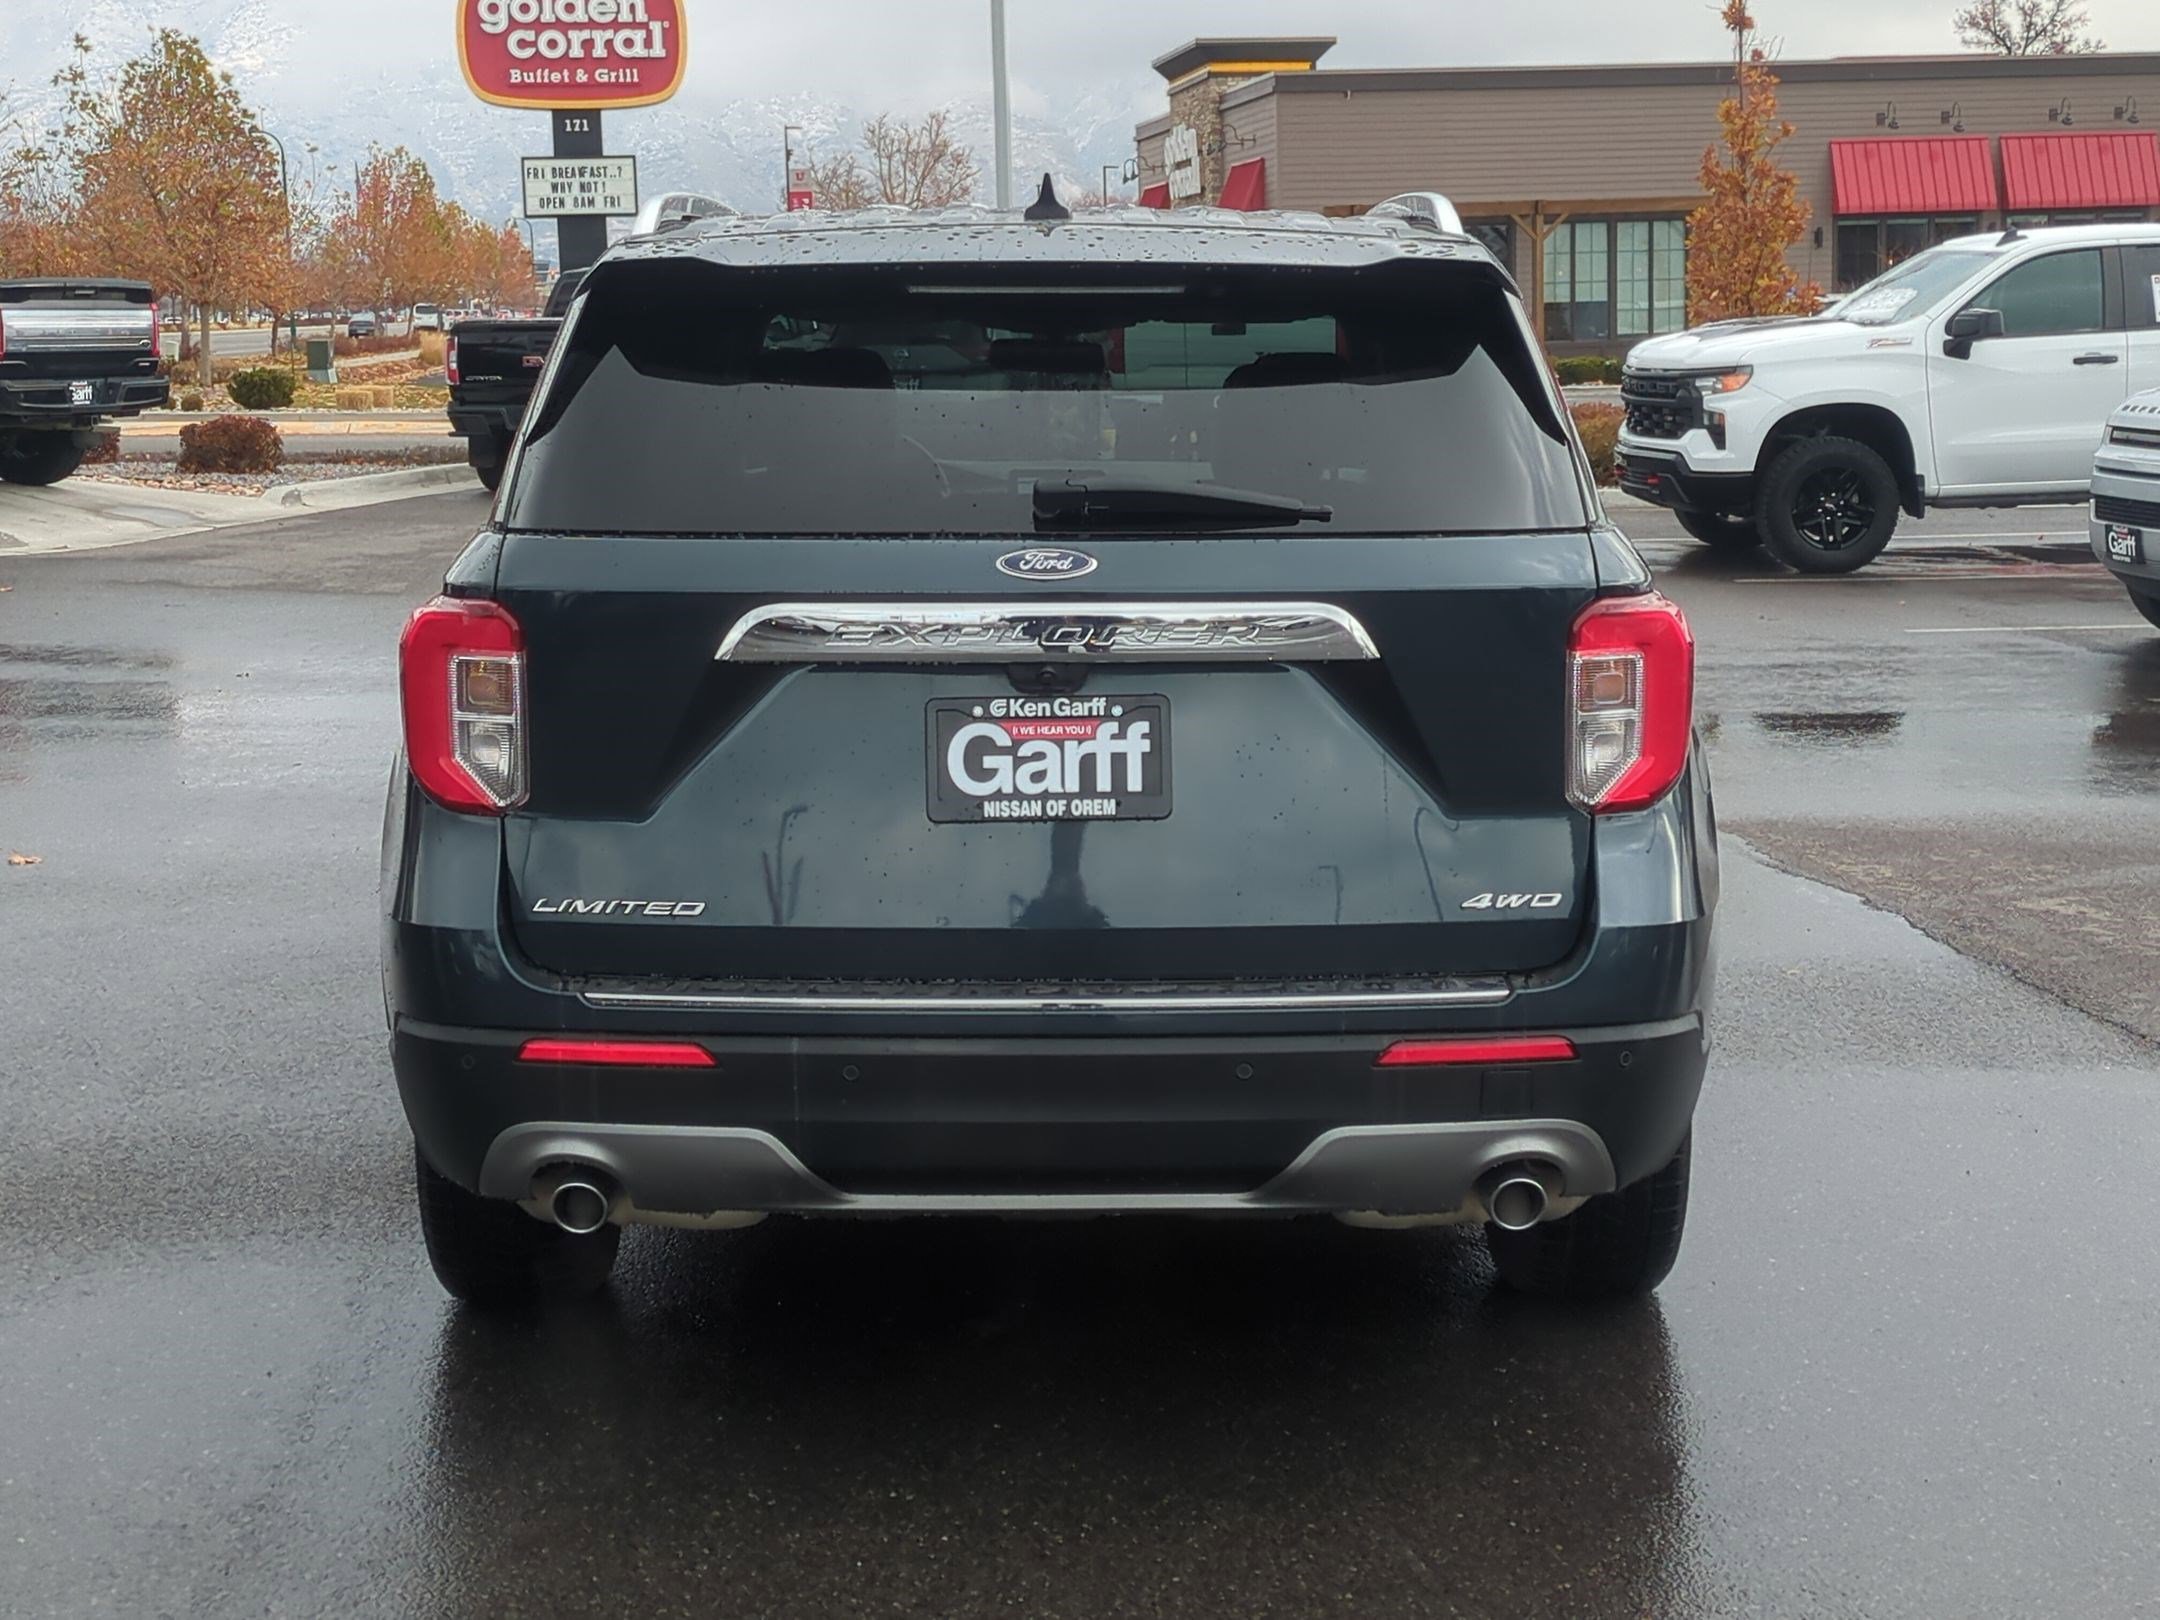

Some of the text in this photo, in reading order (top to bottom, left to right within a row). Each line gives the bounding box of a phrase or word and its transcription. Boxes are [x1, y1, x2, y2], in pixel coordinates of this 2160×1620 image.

[477, 0, 648, 33] golden
[507, 21, 667, 59] corral
[509, 68, 639, 83] Buffet & Grill
[564, 119, 589, 131] 171
[526, 167, 545, 179] FRI
[551, 181, 573, 194] WHY
[540, 195, 621, 209] OPEN 8AM FRI
[2108, 531, 2136, 557] Garff
[1019, 551, 1074, 571] Ford
[825, 622, 1264, 647] EXPLORER
[1009, 697, 1107, 717] Ken Garff
[1037, 725, 1064, 735] HEAR
[1065, 725, 1084, 735] YOU
[947, 721, 1151, 796] Garff
[983, 799, 1116, 817] NISSAN OF OREM
[532, 898, 706, 916] LIMITED
[1461, 893, 1562, 909] 4WD
